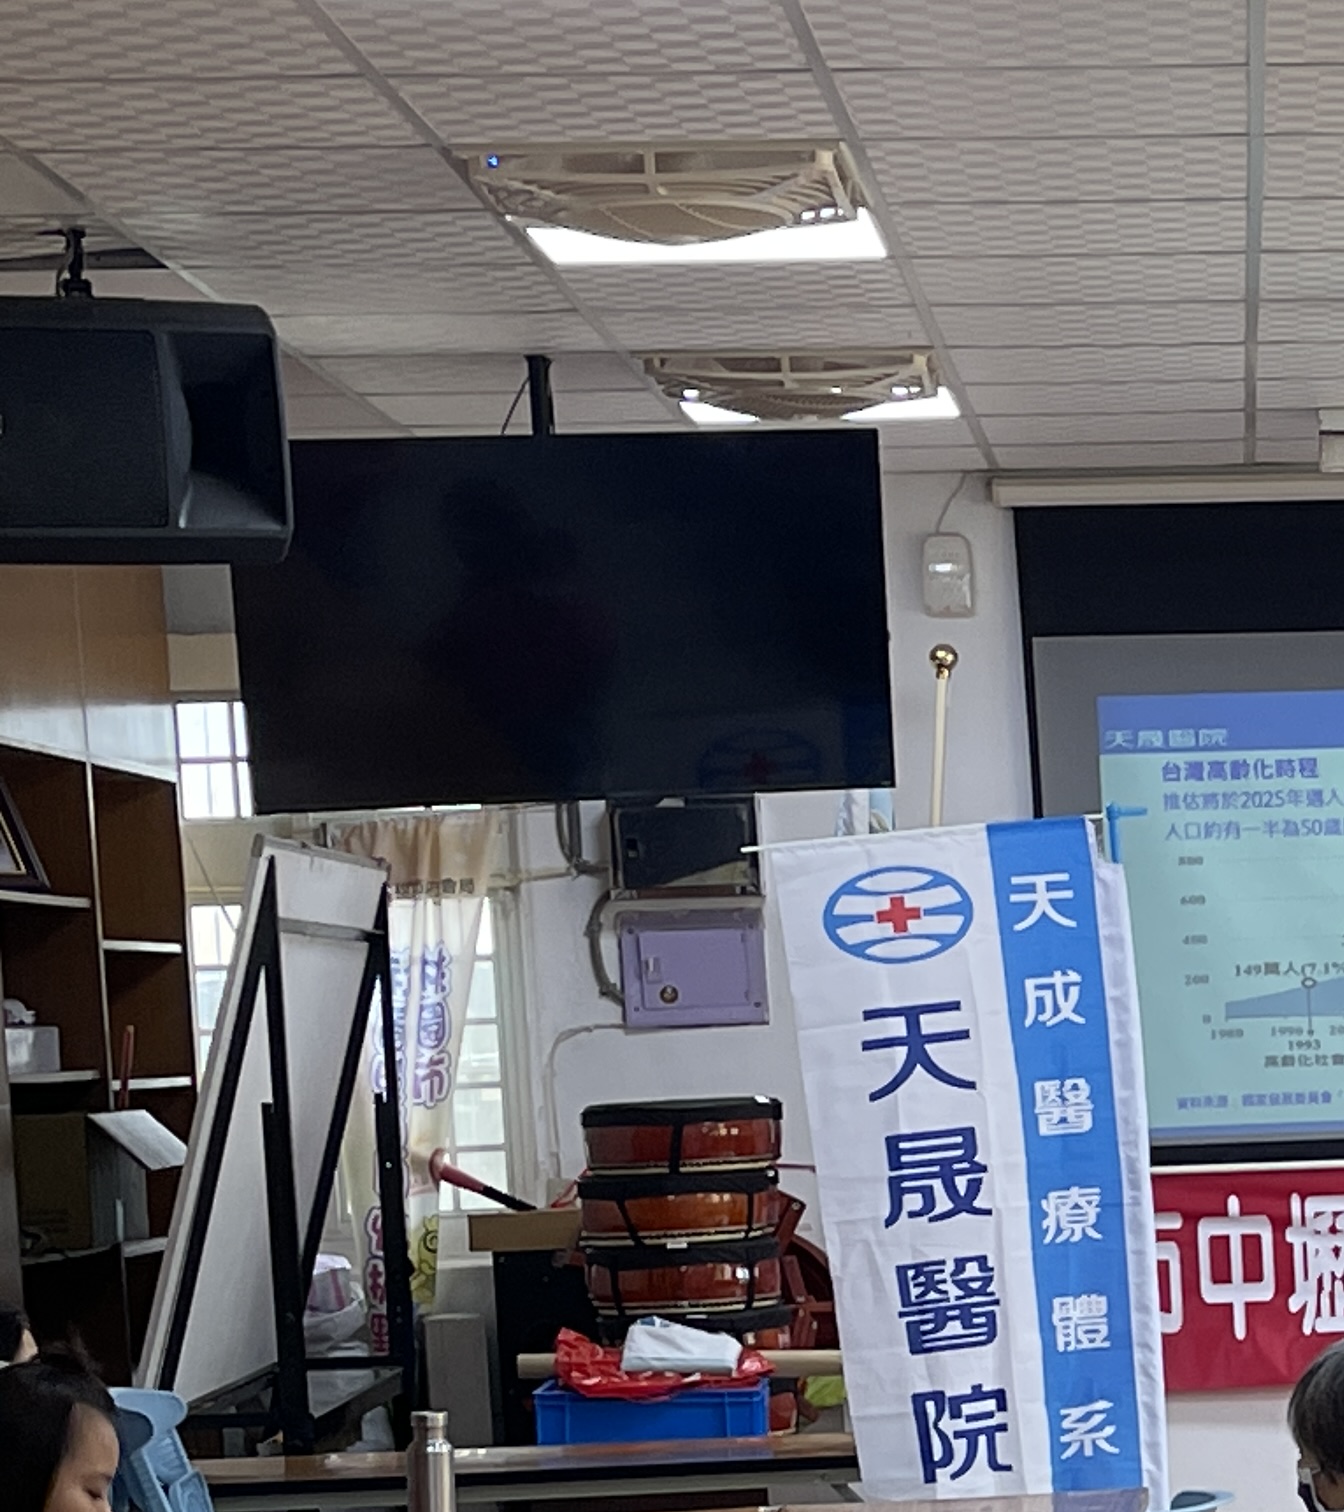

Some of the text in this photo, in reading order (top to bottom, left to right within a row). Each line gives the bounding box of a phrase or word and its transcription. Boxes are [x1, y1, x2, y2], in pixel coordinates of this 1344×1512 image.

[1161, 757, 1320, 783] 台灣高齡化時程
[1180, 895, 1206, 905] 600
[1211, 1028, 1244, 1040] 1980
[1270, 1025, 1304, 1037] 1990
[1287, 1039, 1322, 1051] 1993
[1008, 871, 1121, 1460] 天成醫療體系
[861, 1000, 1012, 1484] 天晟醫院
